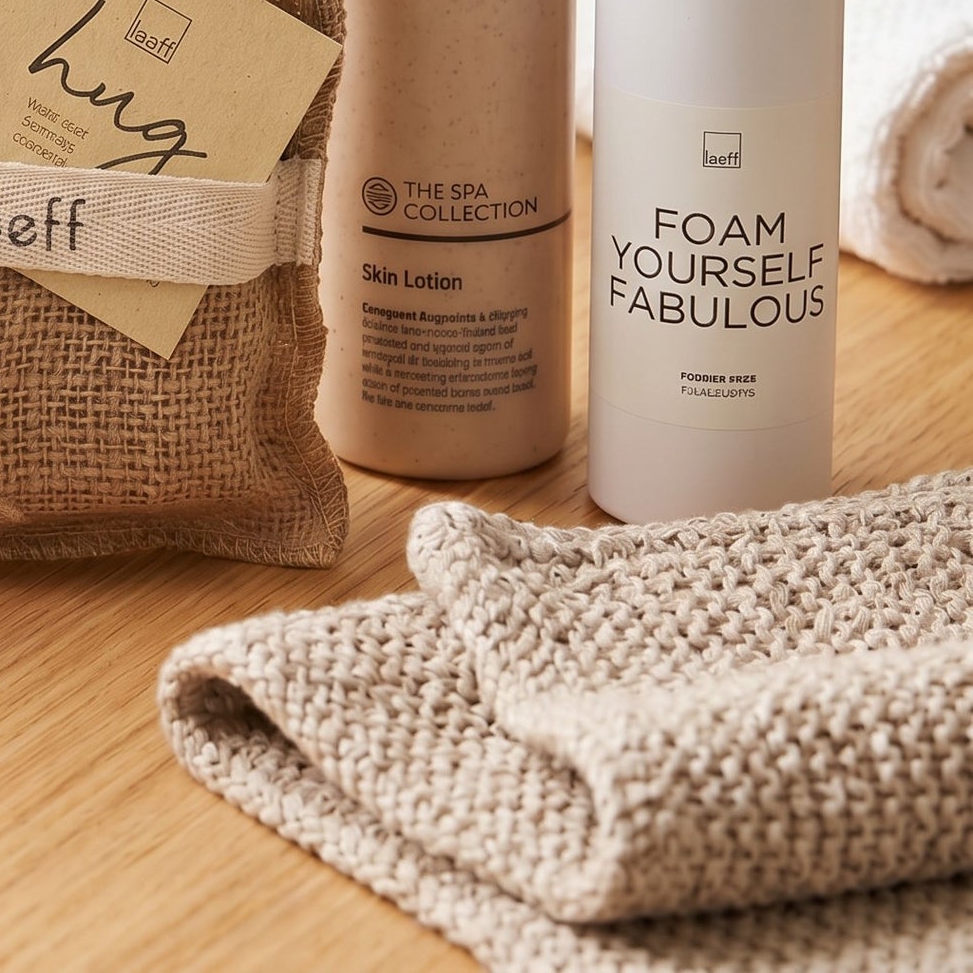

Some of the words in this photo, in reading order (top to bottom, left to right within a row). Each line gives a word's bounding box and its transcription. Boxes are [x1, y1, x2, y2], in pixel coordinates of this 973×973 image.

[705, 150, 739, 166] laeff
[403, 181, 443, 200] THE
[451, 183, 489, 200] SPA
[404, 196, 538, 222] COLLECTION
[655, 207, 786, 246] FOAM
[611, 234, 824, 287] YOURSELF
[362, 263, 398, 286] Skin
[404, 270, 463, 291] Lotion
[610, 275, 824, 329] FABULOUS
